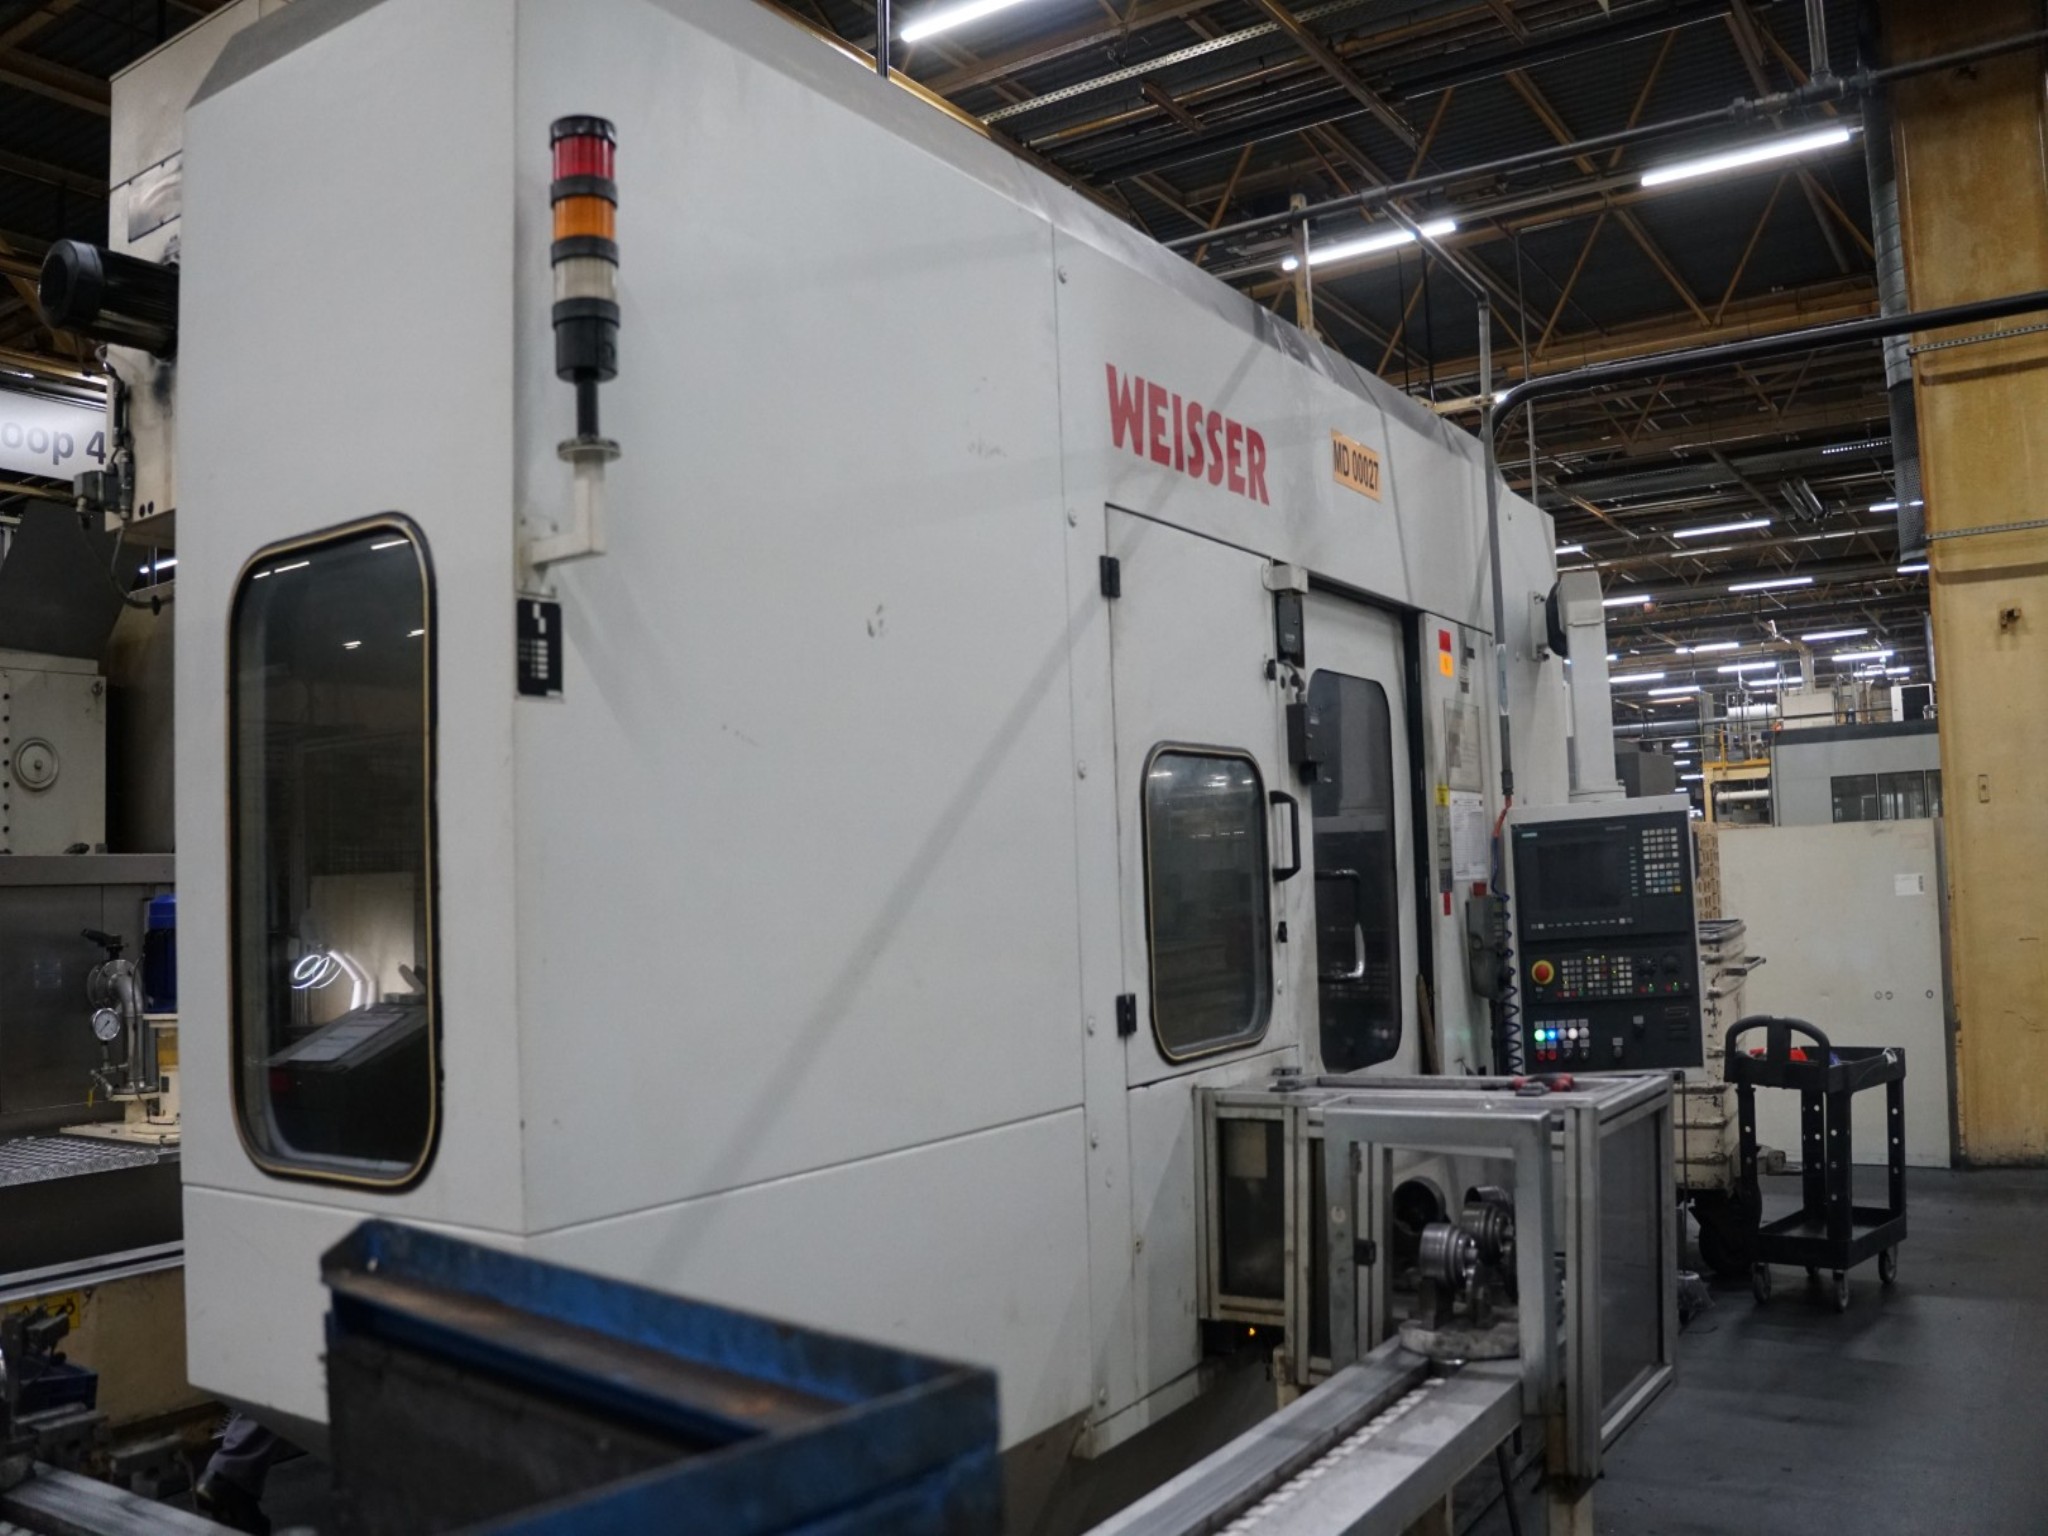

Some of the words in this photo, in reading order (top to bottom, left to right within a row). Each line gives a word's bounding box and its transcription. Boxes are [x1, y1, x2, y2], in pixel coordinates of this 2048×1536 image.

[86, 430, 107, 465] 4
[1105, 362, 1269, 506] WEISSER
[1333, 439, 1350, 477] MD
[1352, 449, 1379, 492] 00027
